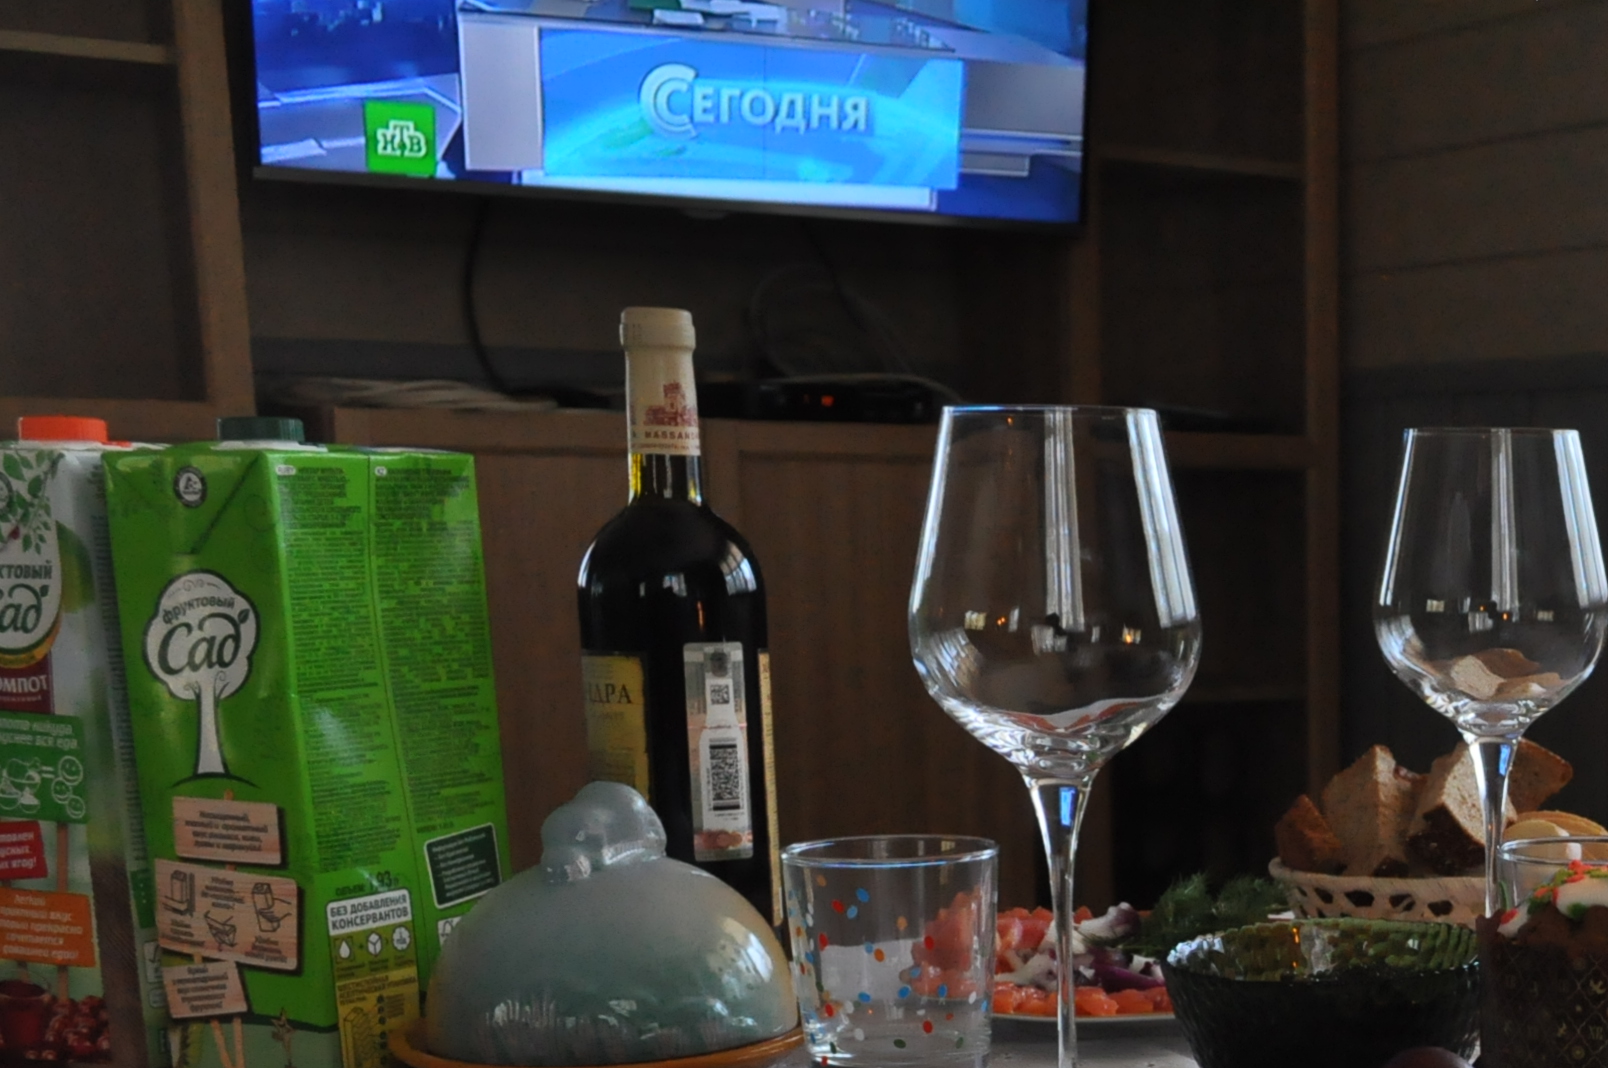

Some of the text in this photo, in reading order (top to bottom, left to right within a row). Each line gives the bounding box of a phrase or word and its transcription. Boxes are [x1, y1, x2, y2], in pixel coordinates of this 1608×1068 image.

[376, 119, 427, 158] НТВ
[0, 584, 42, 634] ад
[162, 596, 235, 624] фруктовый
[158, 612, 242, 675] Сад
[330, 894, 407, 918] БЕЗ ДОБАВЛЕНИЯ
[331, 906, 409, 930] КОНСЕРВАНТОВ
